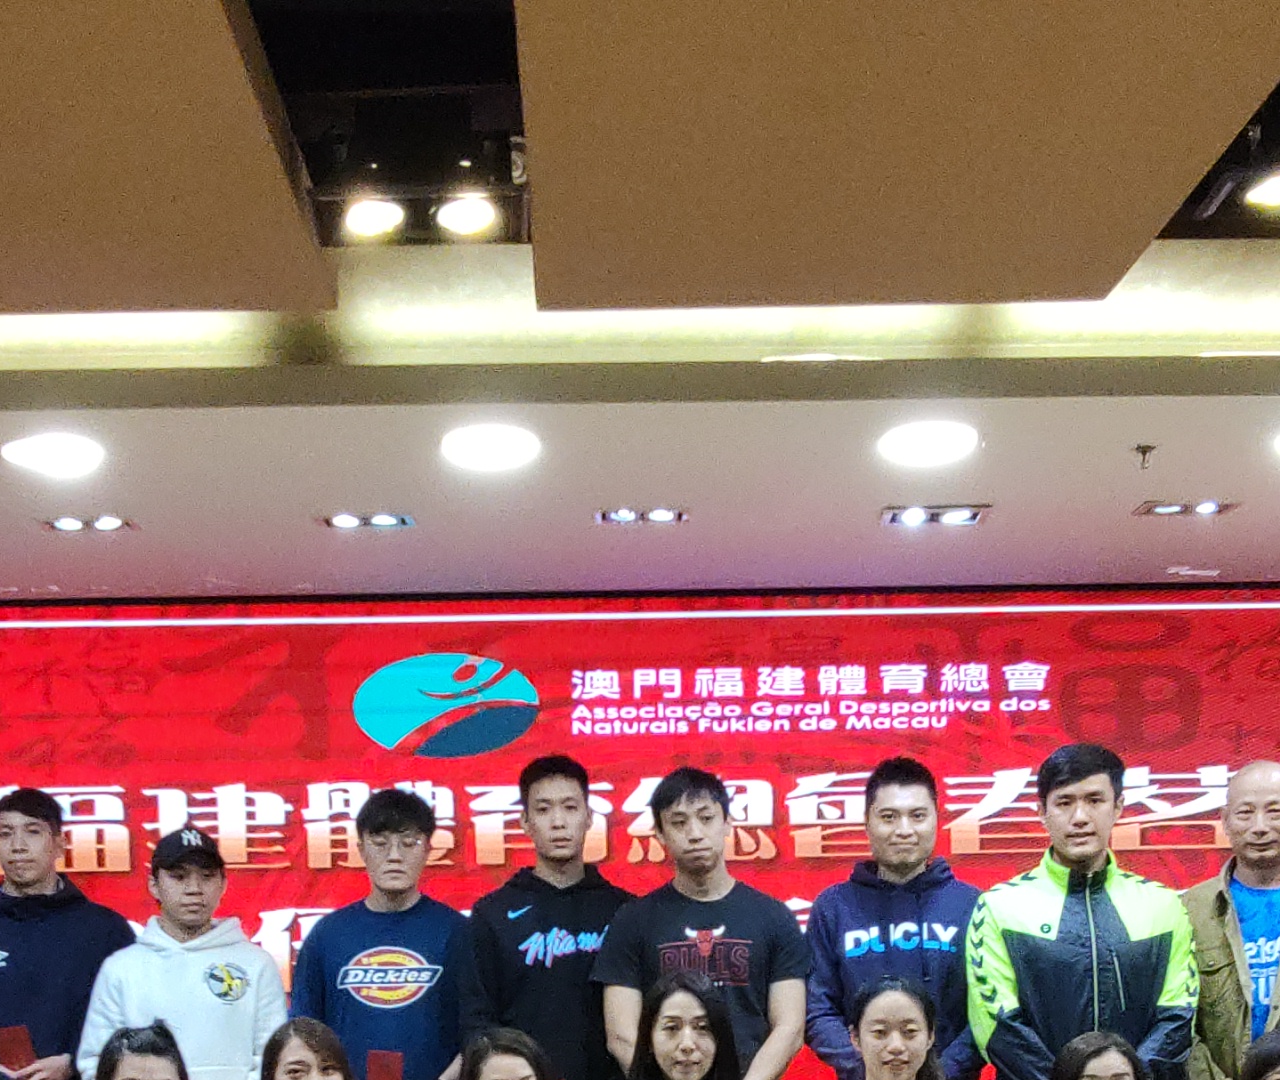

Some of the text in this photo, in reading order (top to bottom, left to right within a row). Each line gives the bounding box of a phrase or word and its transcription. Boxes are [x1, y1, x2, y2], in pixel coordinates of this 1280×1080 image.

[571, 661, 1051, 700] 澳門福建體育總會
[571, 697, 1051, 722] Associação Geral Desportiva dos
[572, 714, 948, 735] Naturais Fukien de Macau
[344, 969, 433, 984] Dickies
